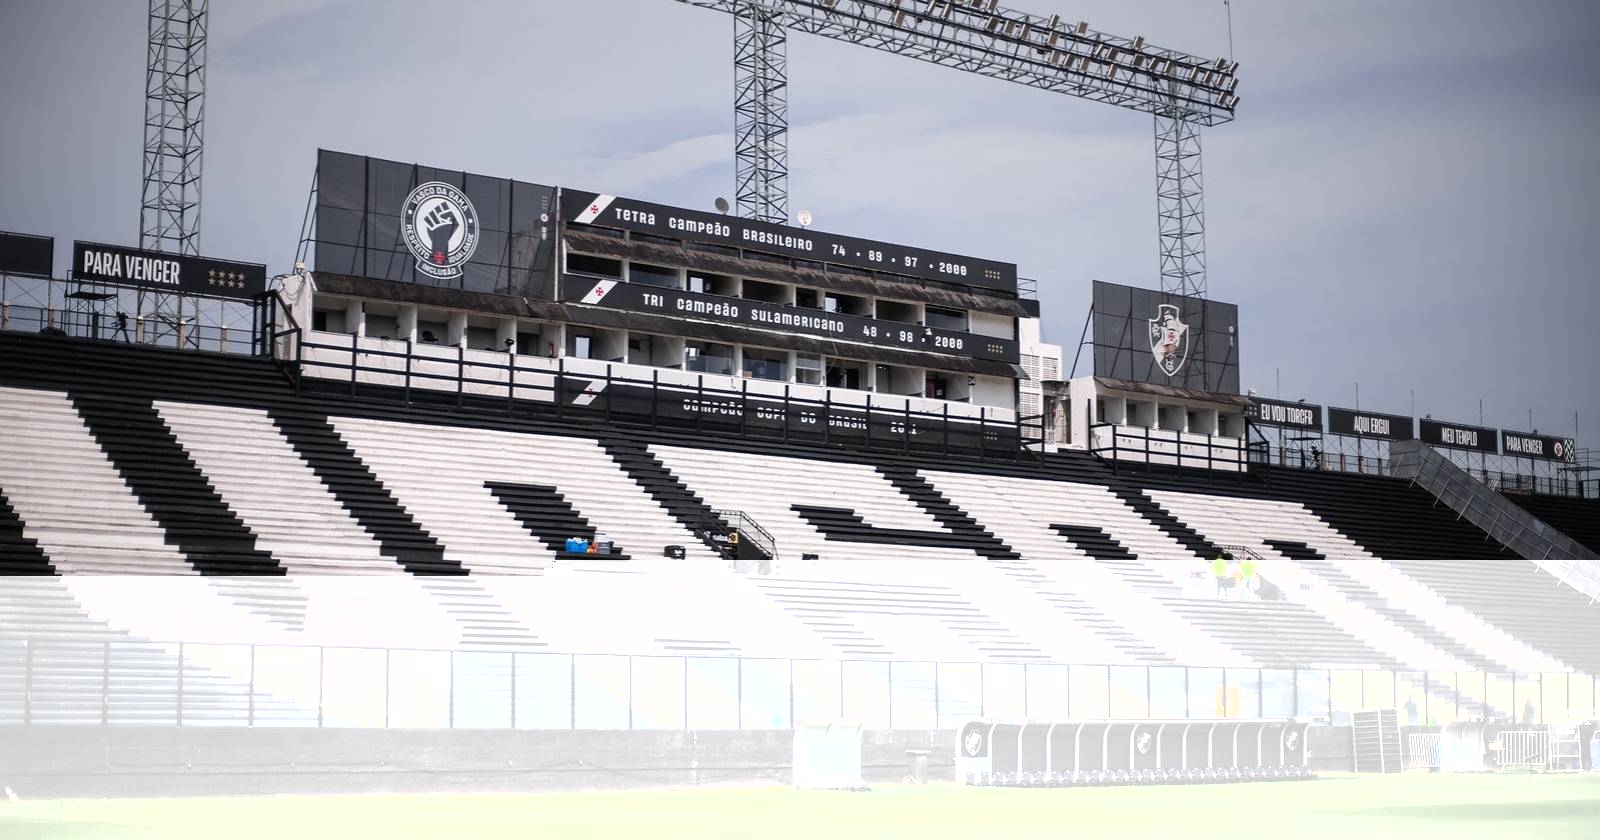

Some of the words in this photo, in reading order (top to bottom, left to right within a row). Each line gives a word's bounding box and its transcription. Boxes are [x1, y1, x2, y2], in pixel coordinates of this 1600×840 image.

[411, 187, 435, 205] VASCO
[436, 187, 447, 195] DA
[448, 191, 468, 212] GAMA
[406, 224, 430, 260] RESPEITO
[448, 233, 474, 264] IGUALDADE
[84, 250, 122, 277] PARA
[126, 256, 180, 285] VENCER
[422, 263, 457, 276] INCLUSÃO
[831, 244, 846, 257] 74
[868, 250, 882, 262] 89
[904, 256, 918, 268] 97
[939, 262, 967, 276] 2000
[643, 293, 664, 307] TRI
[863, 325, 877, 338] 48
[900, 330, 913, 343] 98
[935, 336, 963, 350] 2000
[1261, 403, 1271, 420] EU
[1271, 404, 1286, 423] VOU
[890, 421, 917, 435] 201
[1354, 415, 1370, 434] AQUI
[1370, 417, 1390, 435] ERGUI
[1441, 427, 1455, 443] MEU
[1455, 429, 1478, 446] TEMPLO
[1506, 435, 1522, 452] PARA
